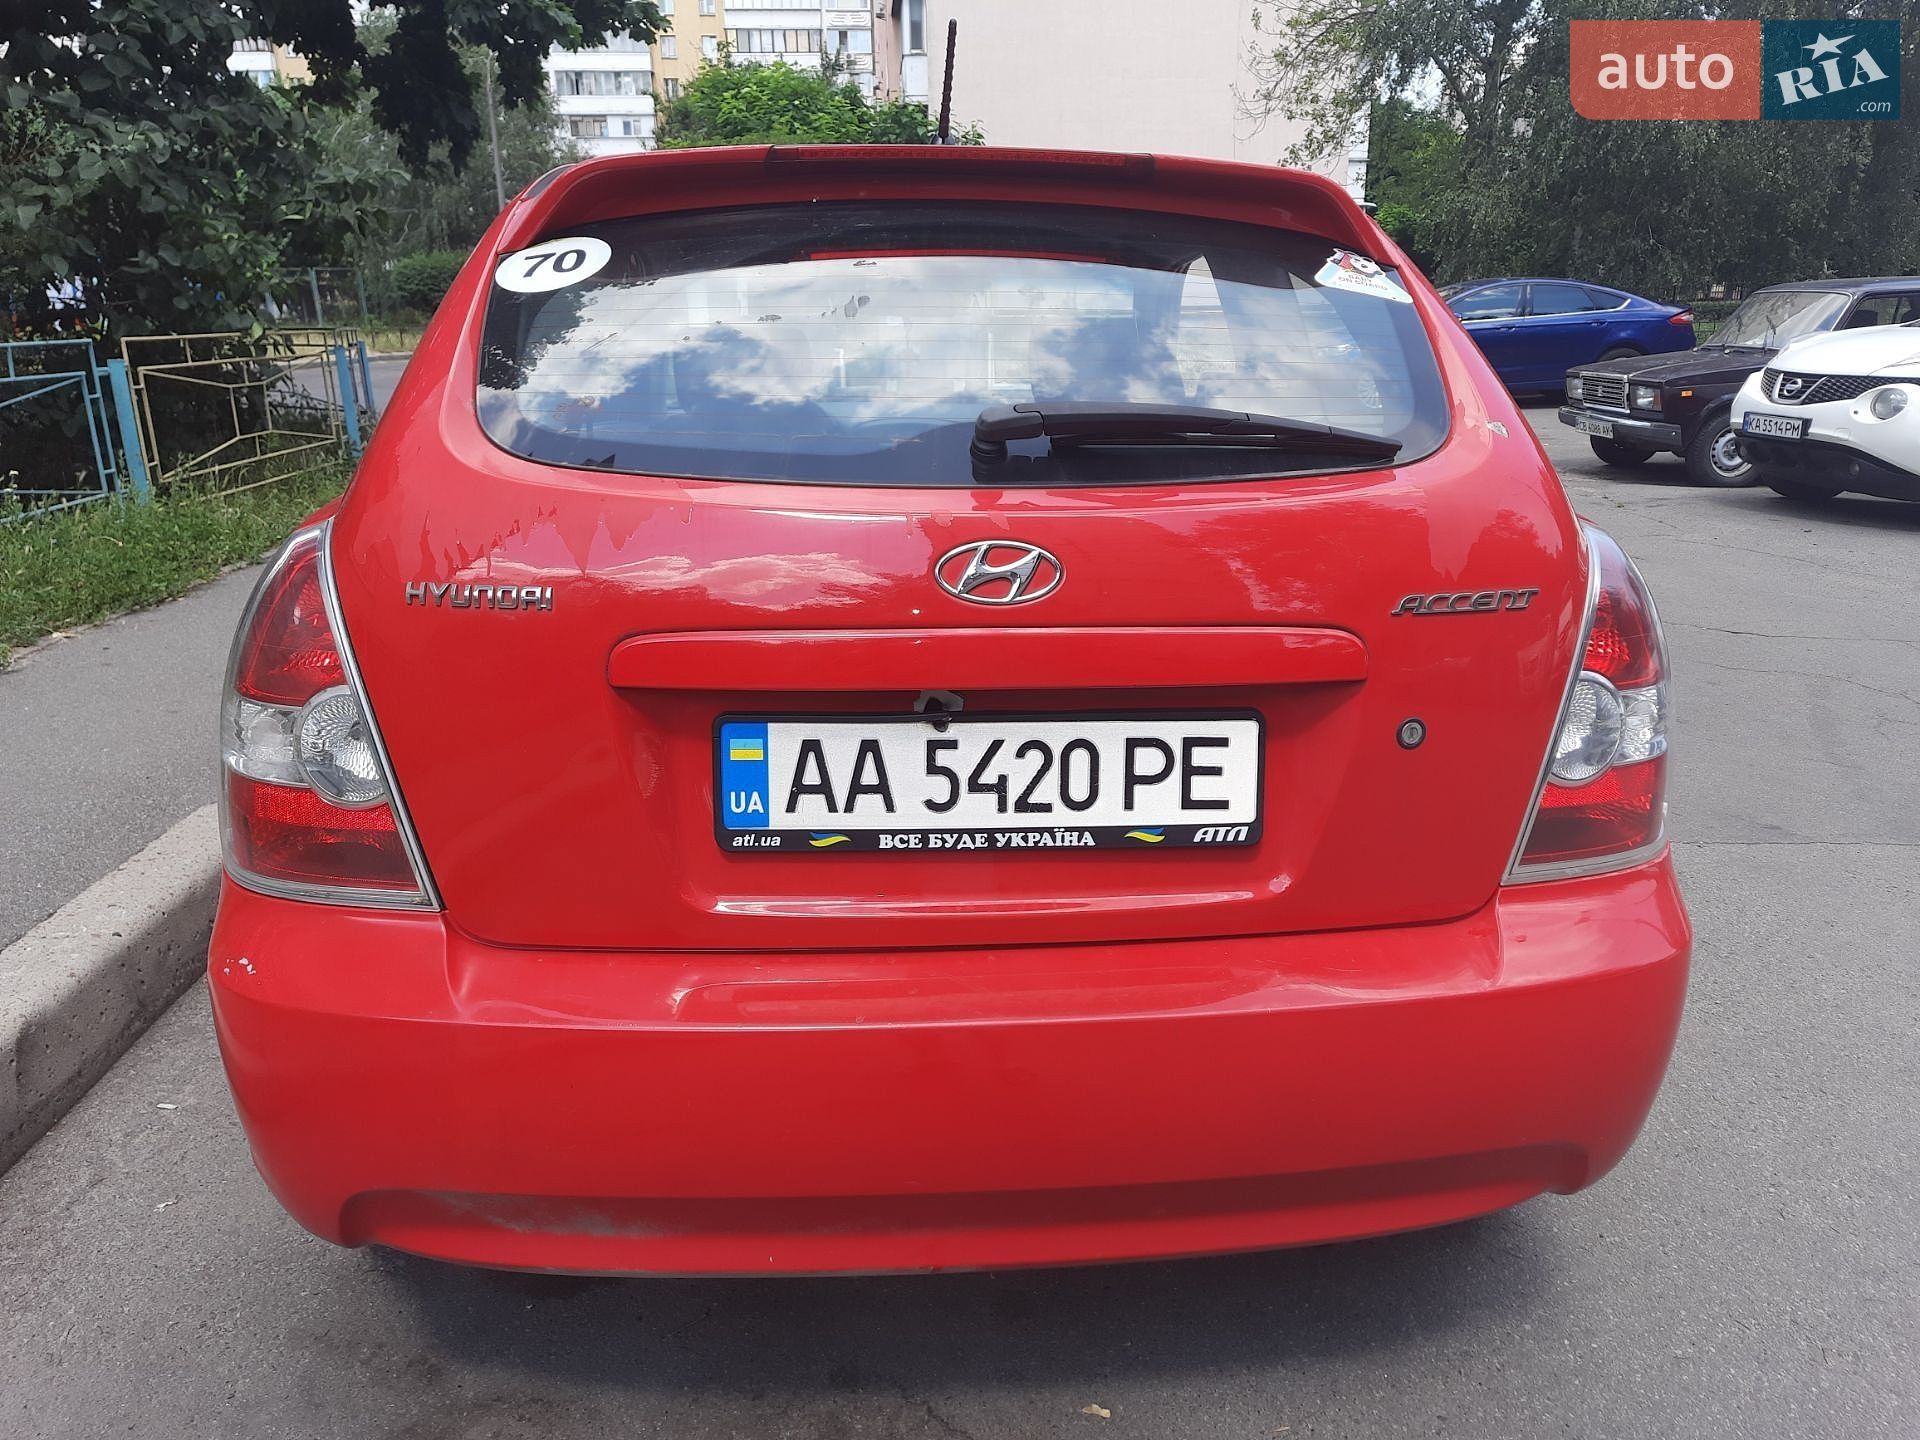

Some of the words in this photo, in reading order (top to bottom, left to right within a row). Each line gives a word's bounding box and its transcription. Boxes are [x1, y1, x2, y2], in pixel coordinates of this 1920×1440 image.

[523, 249, 587, 278] 70
[1762, 418, 1784, 435] 5514
[405, 581, 554, 610] HYUNDAI
[1391, 588, 1540, 615] ACCENT
[785, 738, 896, 814] AA
[921, 737, 1100, 814] 5420
[1122, 736, 1230, 812] PE
[729, 792, 764, 814] UA
[732, 833, 782, 847] atl.ua
[878, 833, 923, 849] ВСЕ
[927, 832, 989, 850] БУДЕ
[994, 828, 1096, 848] УКРАЇНА
